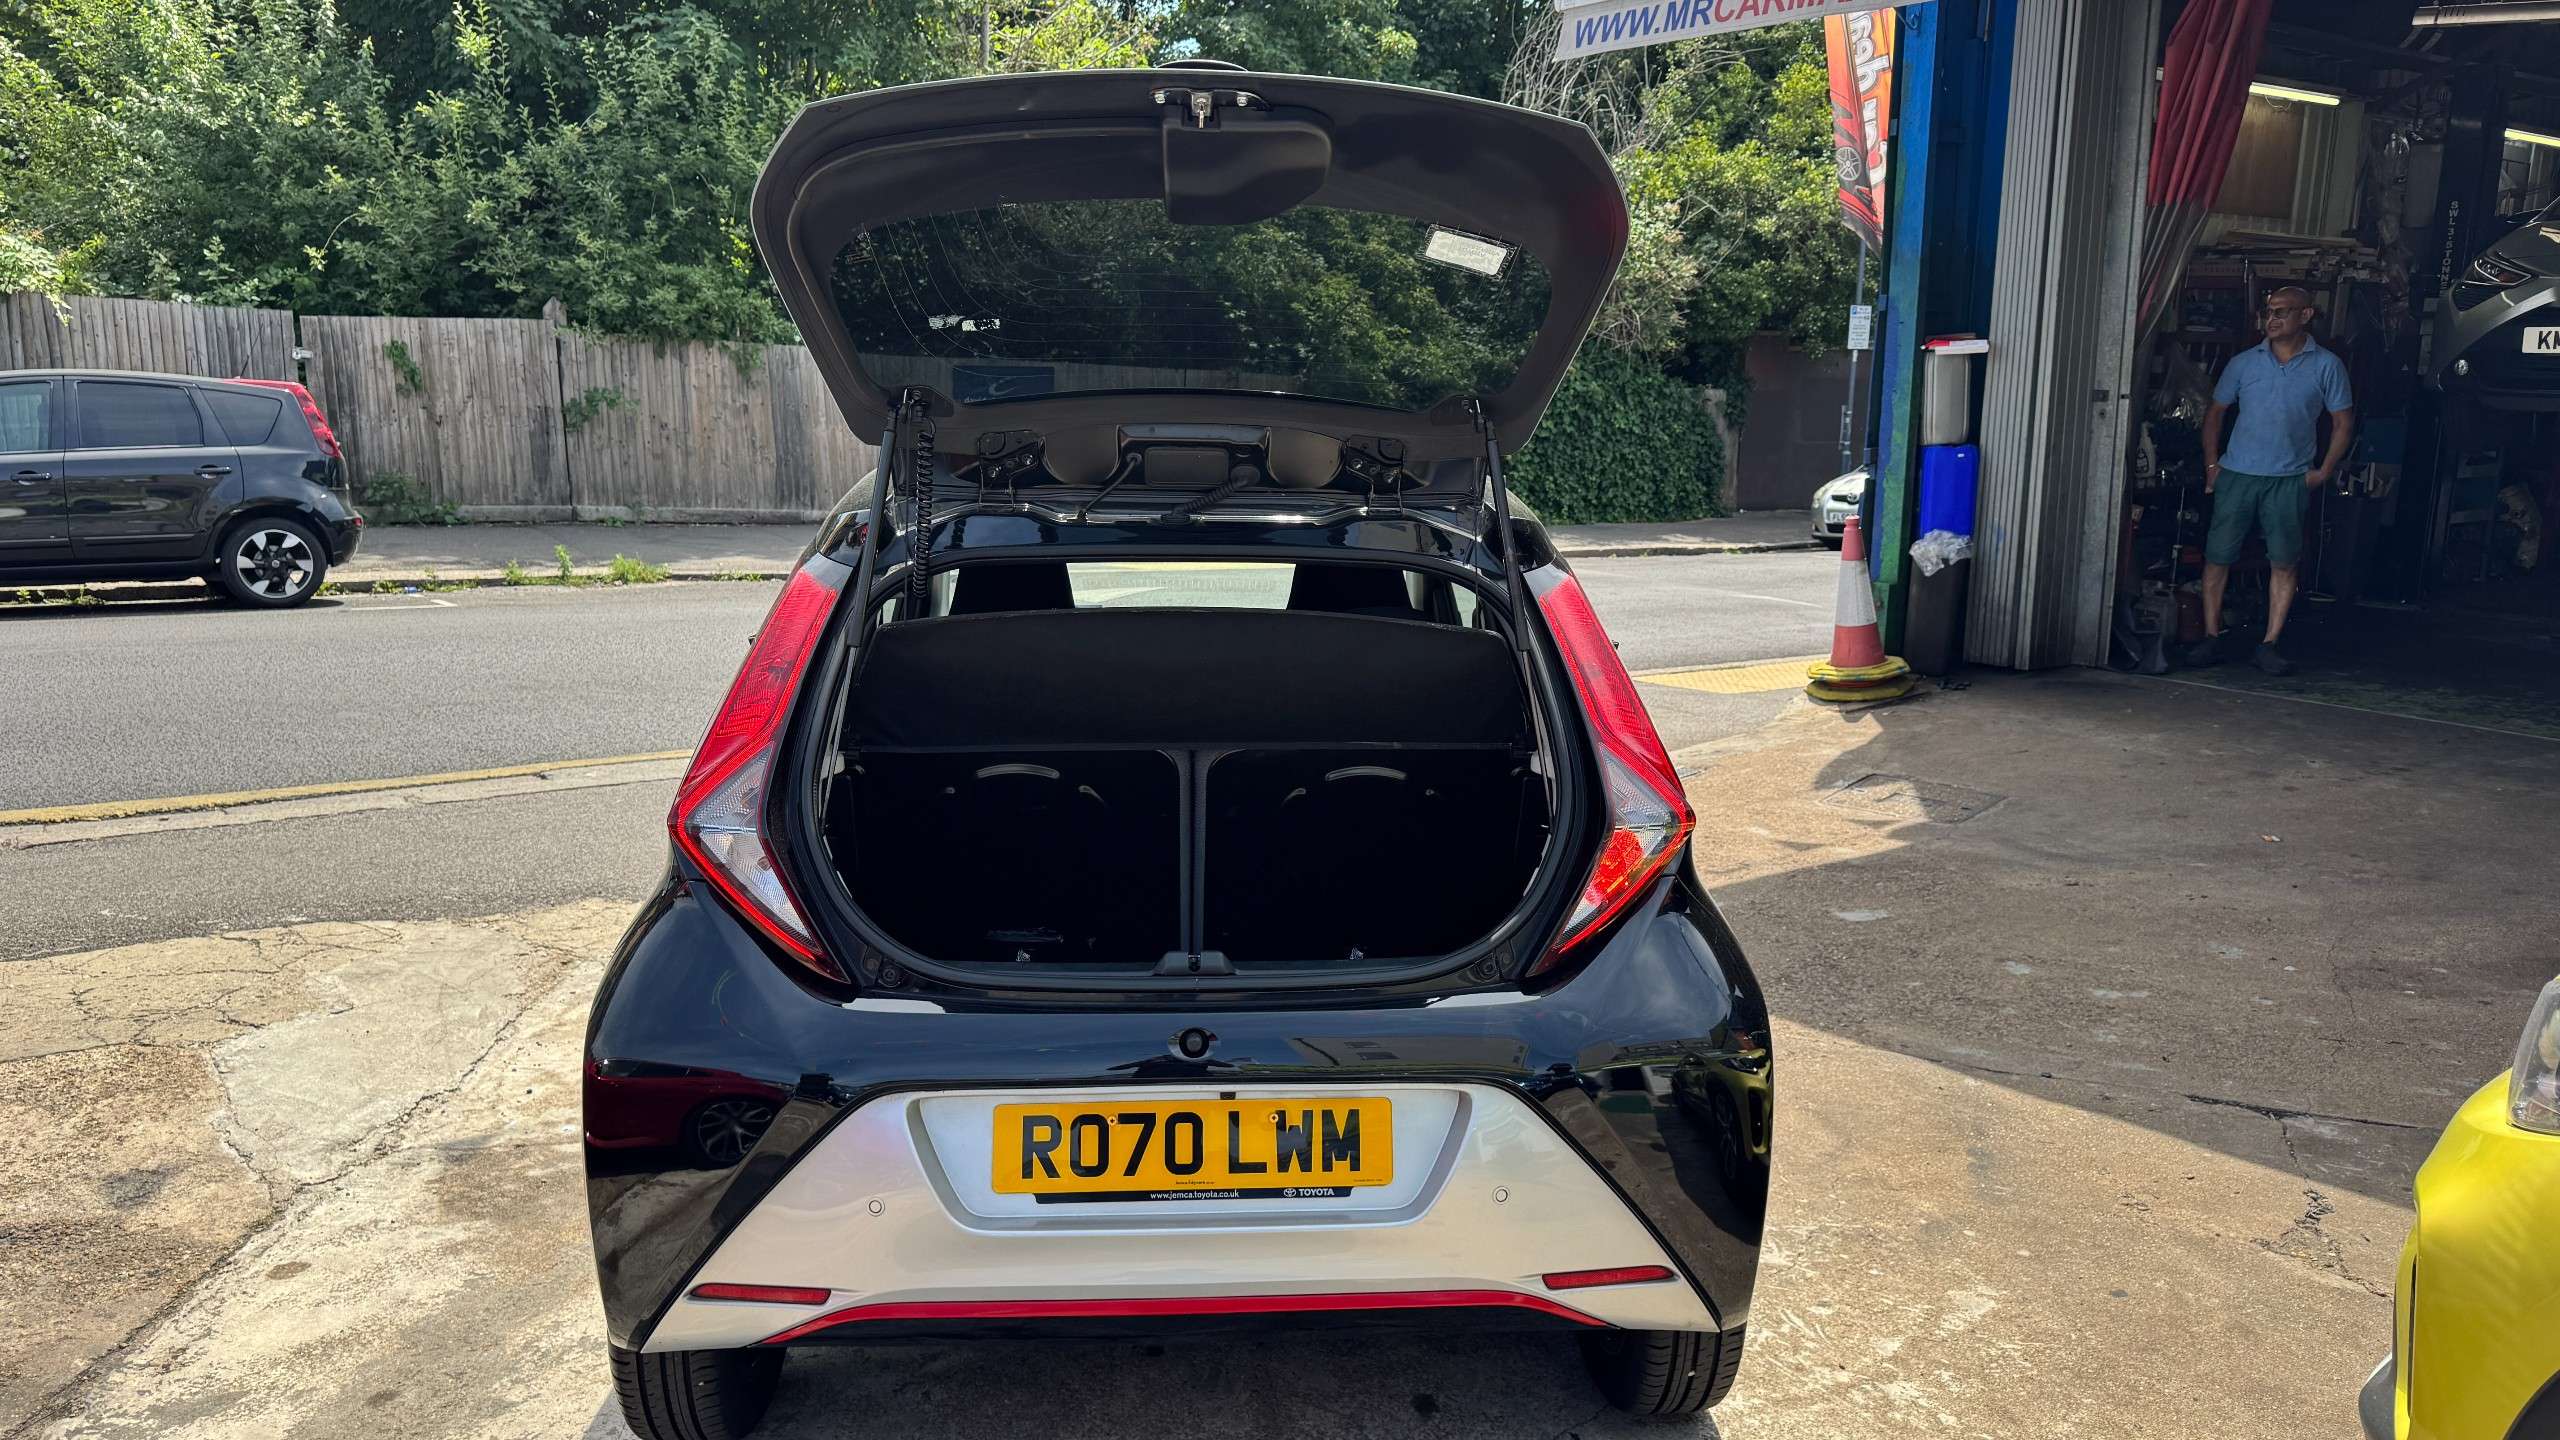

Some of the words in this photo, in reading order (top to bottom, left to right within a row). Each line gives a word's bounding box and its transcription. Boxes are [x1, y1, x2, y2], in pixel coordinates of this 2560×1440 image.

[1021, 1112, 1205, 1180] RO70
[1228, 1108, 1361, 1176] LWM
[1150, 1189, 1240, 1200] www.jemca.toyota.co.uk
[1298, 1188, 1335, 1197] TOYOTA
